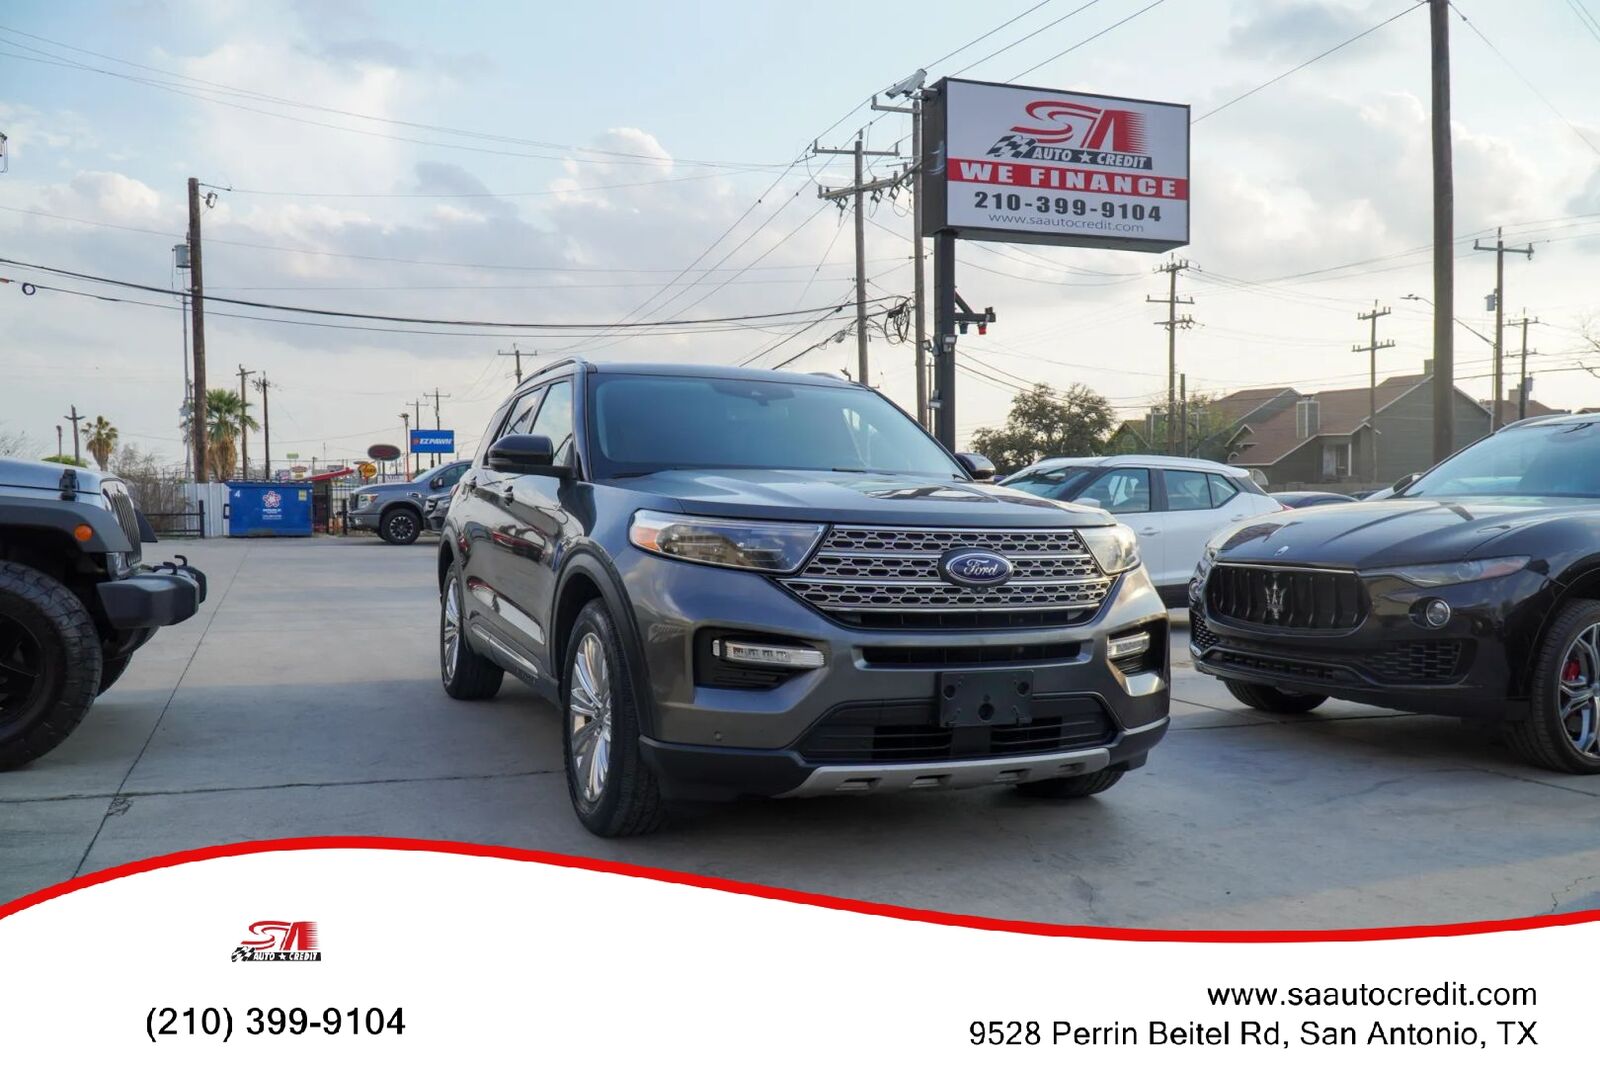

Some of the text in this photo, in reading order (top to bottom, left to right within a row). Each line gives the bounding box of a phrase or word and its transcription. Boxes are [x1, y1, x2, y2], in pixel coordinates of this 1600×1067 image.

[1031, 146, 1147, 169] AUTO CREDIT
[959, 162, 1177, 198] WE FINANCE
[974, 191, 1162, 222] 210-399-9104
[988, 213, 1145, 233] www.saautocredit.com
[963, 558, 999, 576] Ford
